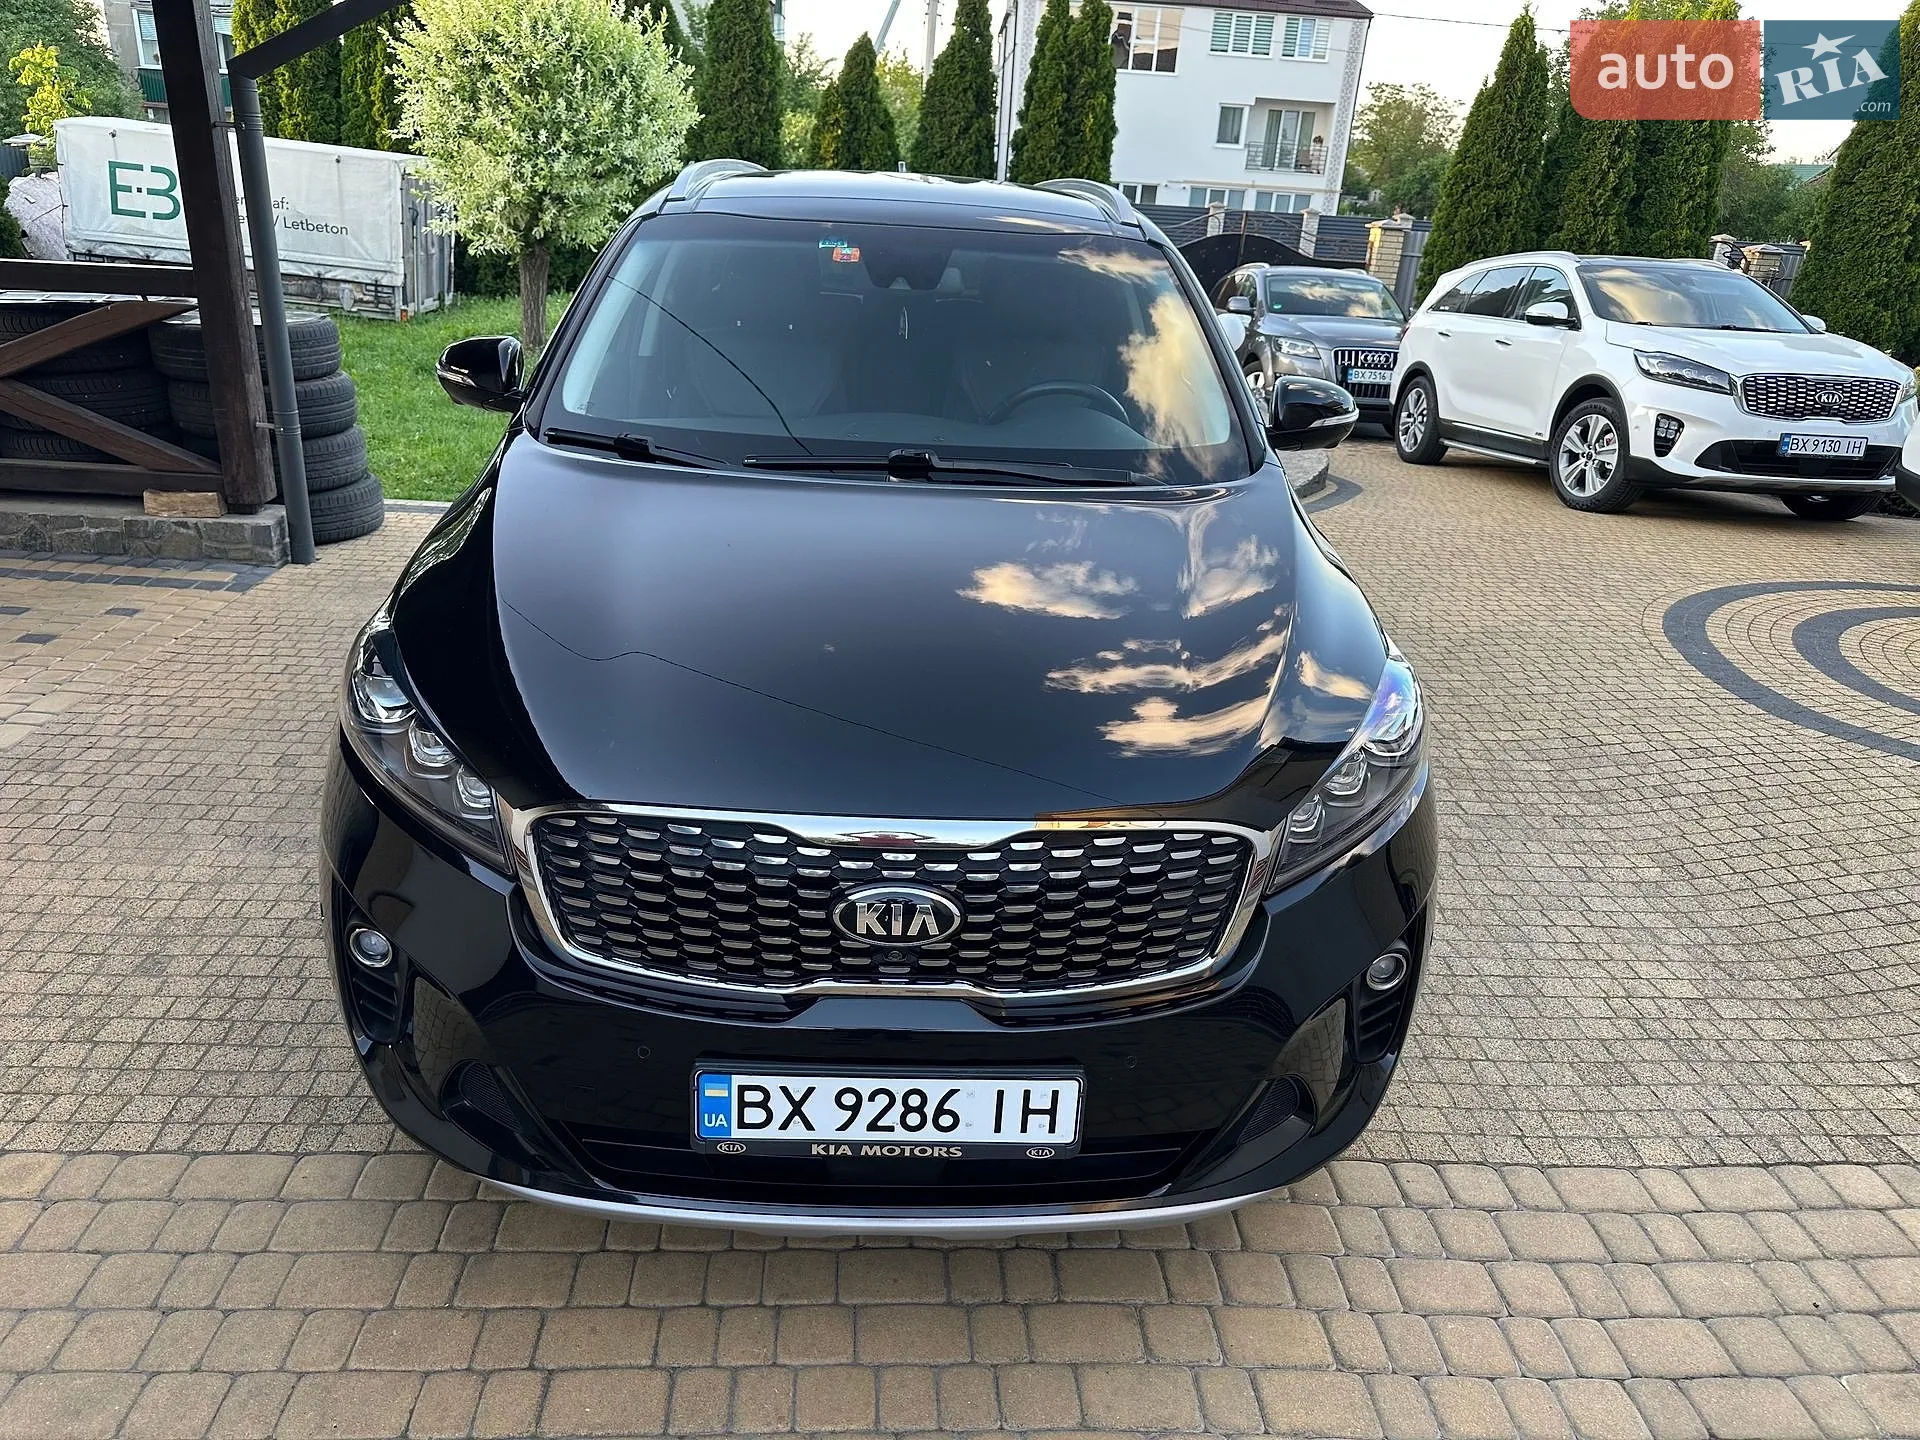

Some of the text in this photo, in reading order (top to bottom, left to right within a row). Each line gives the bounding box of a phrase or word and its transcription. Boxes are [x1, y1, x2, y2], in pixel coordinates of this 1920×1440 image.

[283, 216, 349, 236] Letbeton
[1353, 370, 1366, 380] BX
[1820, 393, 1840, 403] KIA
[1789, 437, 1863, 455] BX 9130 IH
[855, 902, 940, 936] KIA
[736, 1084, 1060, 1135] BX 9286 IH
[704, 1113, 728, 1128] UA
[721, 1143, 742, 1152] KIA
[811, 1143, 963, 1158] KIA MOTORS
